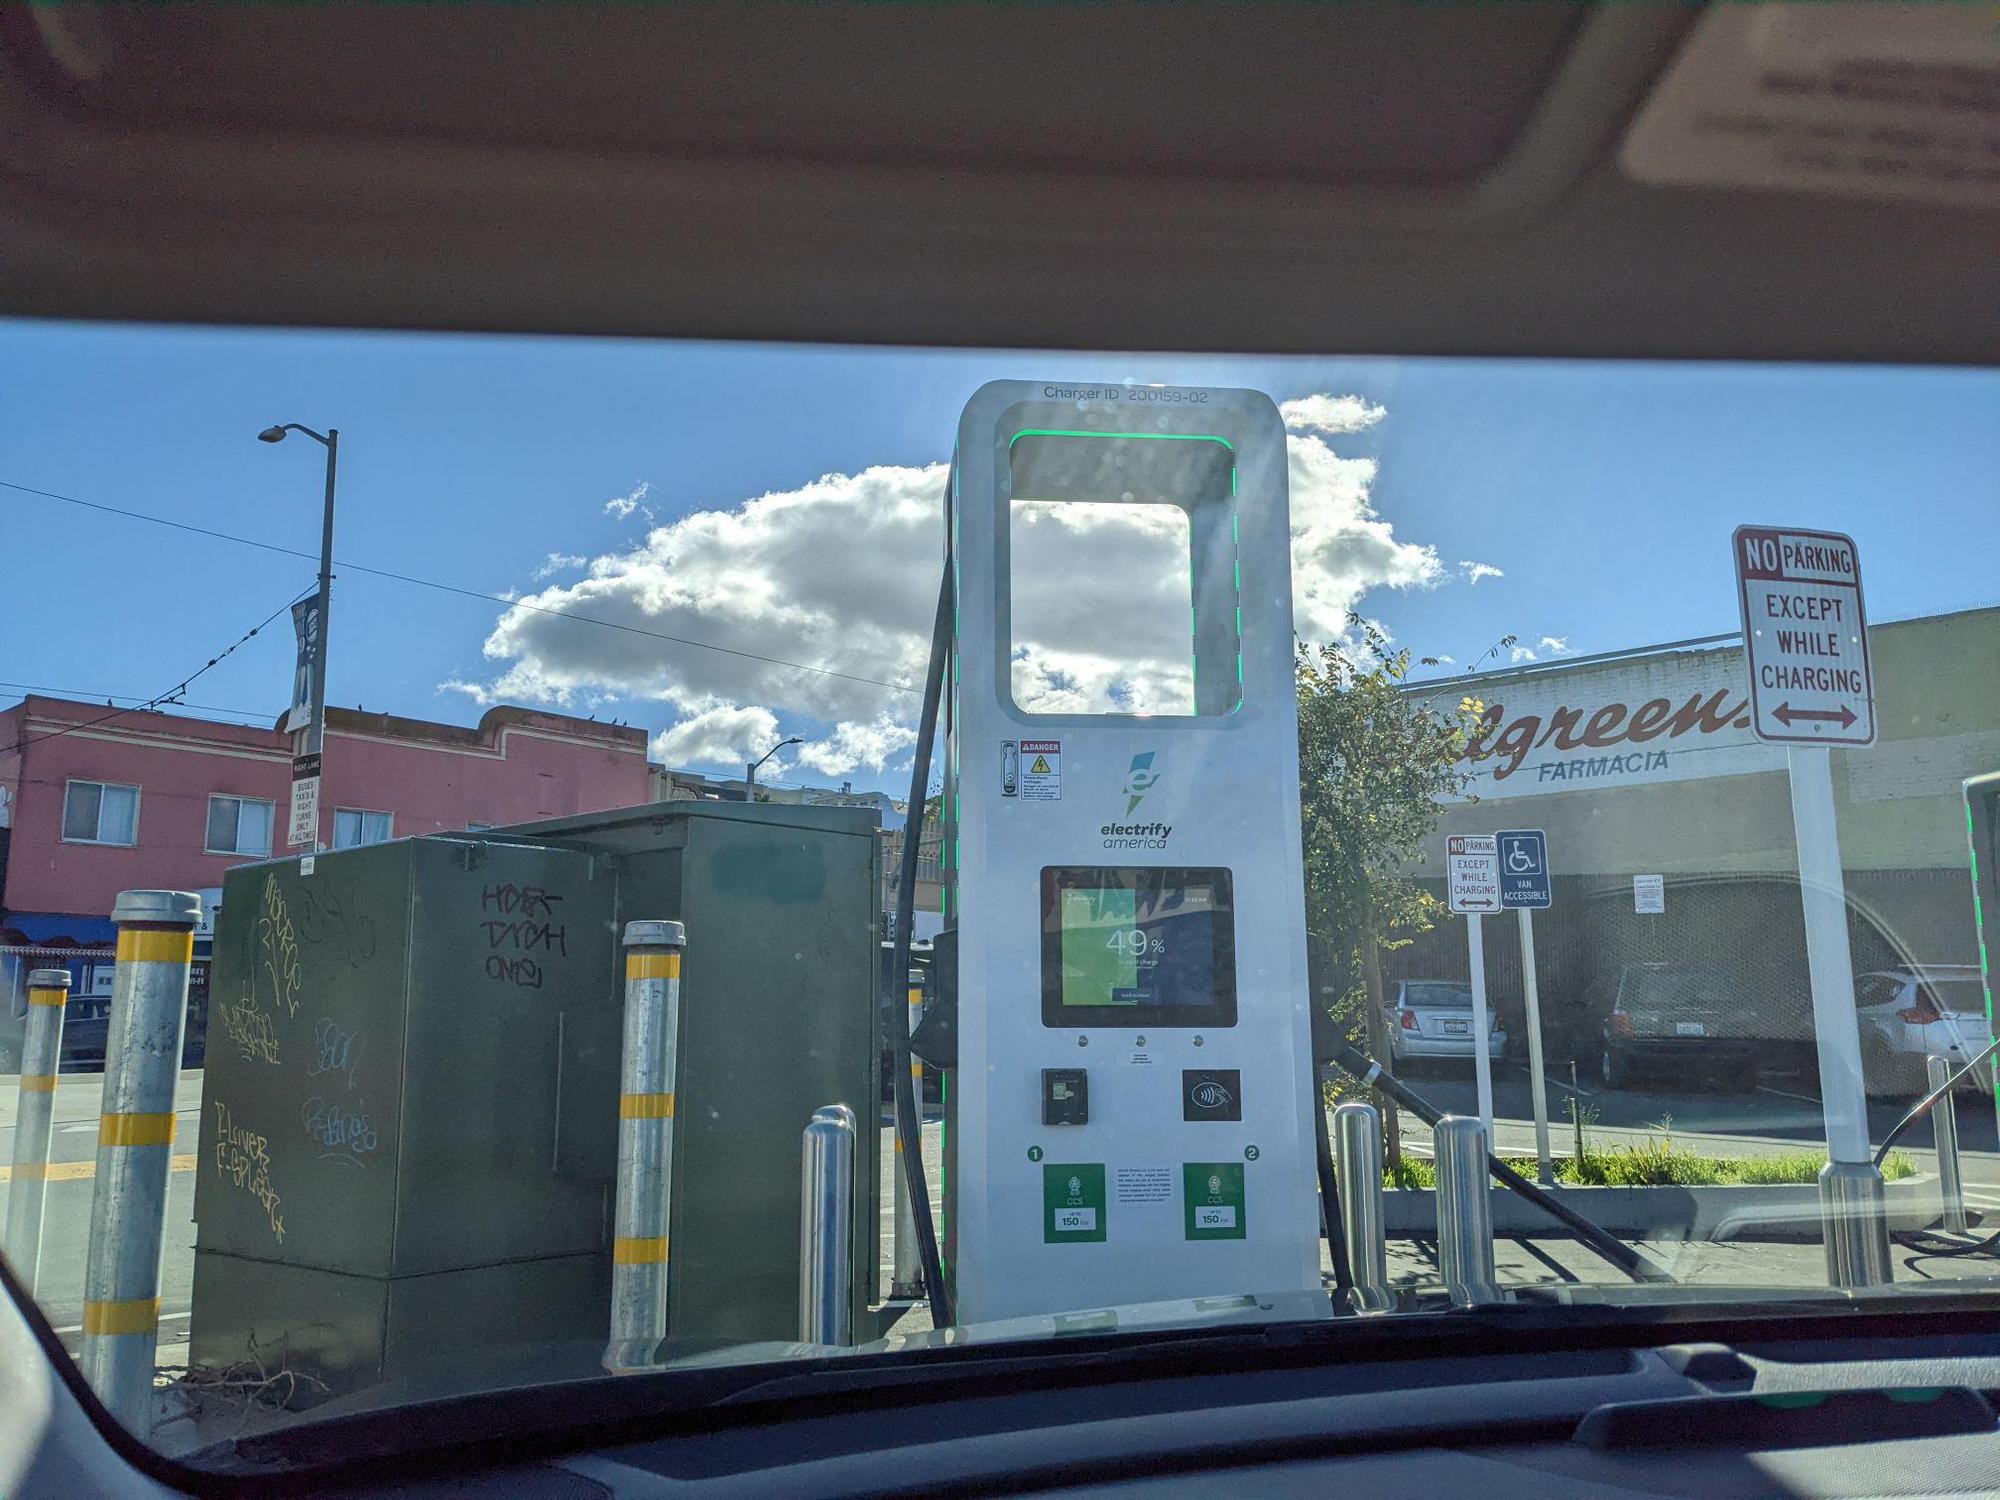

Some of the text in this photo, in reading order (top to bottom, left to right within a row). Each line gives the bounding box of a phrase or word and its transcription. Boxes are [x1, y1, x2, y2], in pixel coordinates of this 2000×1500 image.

[1044, 386, 1208, 404] Charger ID 200159-02
[1744, 537, 1852, 574] NO PARKING
[1766, 593, 1842, 622] EXCEPT
[1776, 629, 1840, 657] WHILE
[1761, 664, 1862, 694] CHARGING
[1029, 743, 1059, 751] DANGER
[1538, 749, 1669, 782] FARMACIA
[296, 822, 309, 832] ONLY
[1101, 822, 1172, 838] electrify
[1103, 837, 1167, 849] america
[1450, 839, 1495, 852] NO PARKING
[1457, 859, 1489, 870] EXCEPT
[1460, 872, 1488, 882] WHILE
[1454, 885, 1496, 895] CHARGING
[1516, 880, 1532, 889] VAN
[1503, 890, 1548, 901] ACCESSIBLE
[1032, 1148, 1038, 1160] 1
[1248, 1147, 1256, 1159] 2
[1067, 1197, 1084, 1206] CCS
[1207, 1195, 1223, 1204] CCS
[1062, 1217, 1079, 1226] 150
[1202, 1215, 1219, 1224] 150
